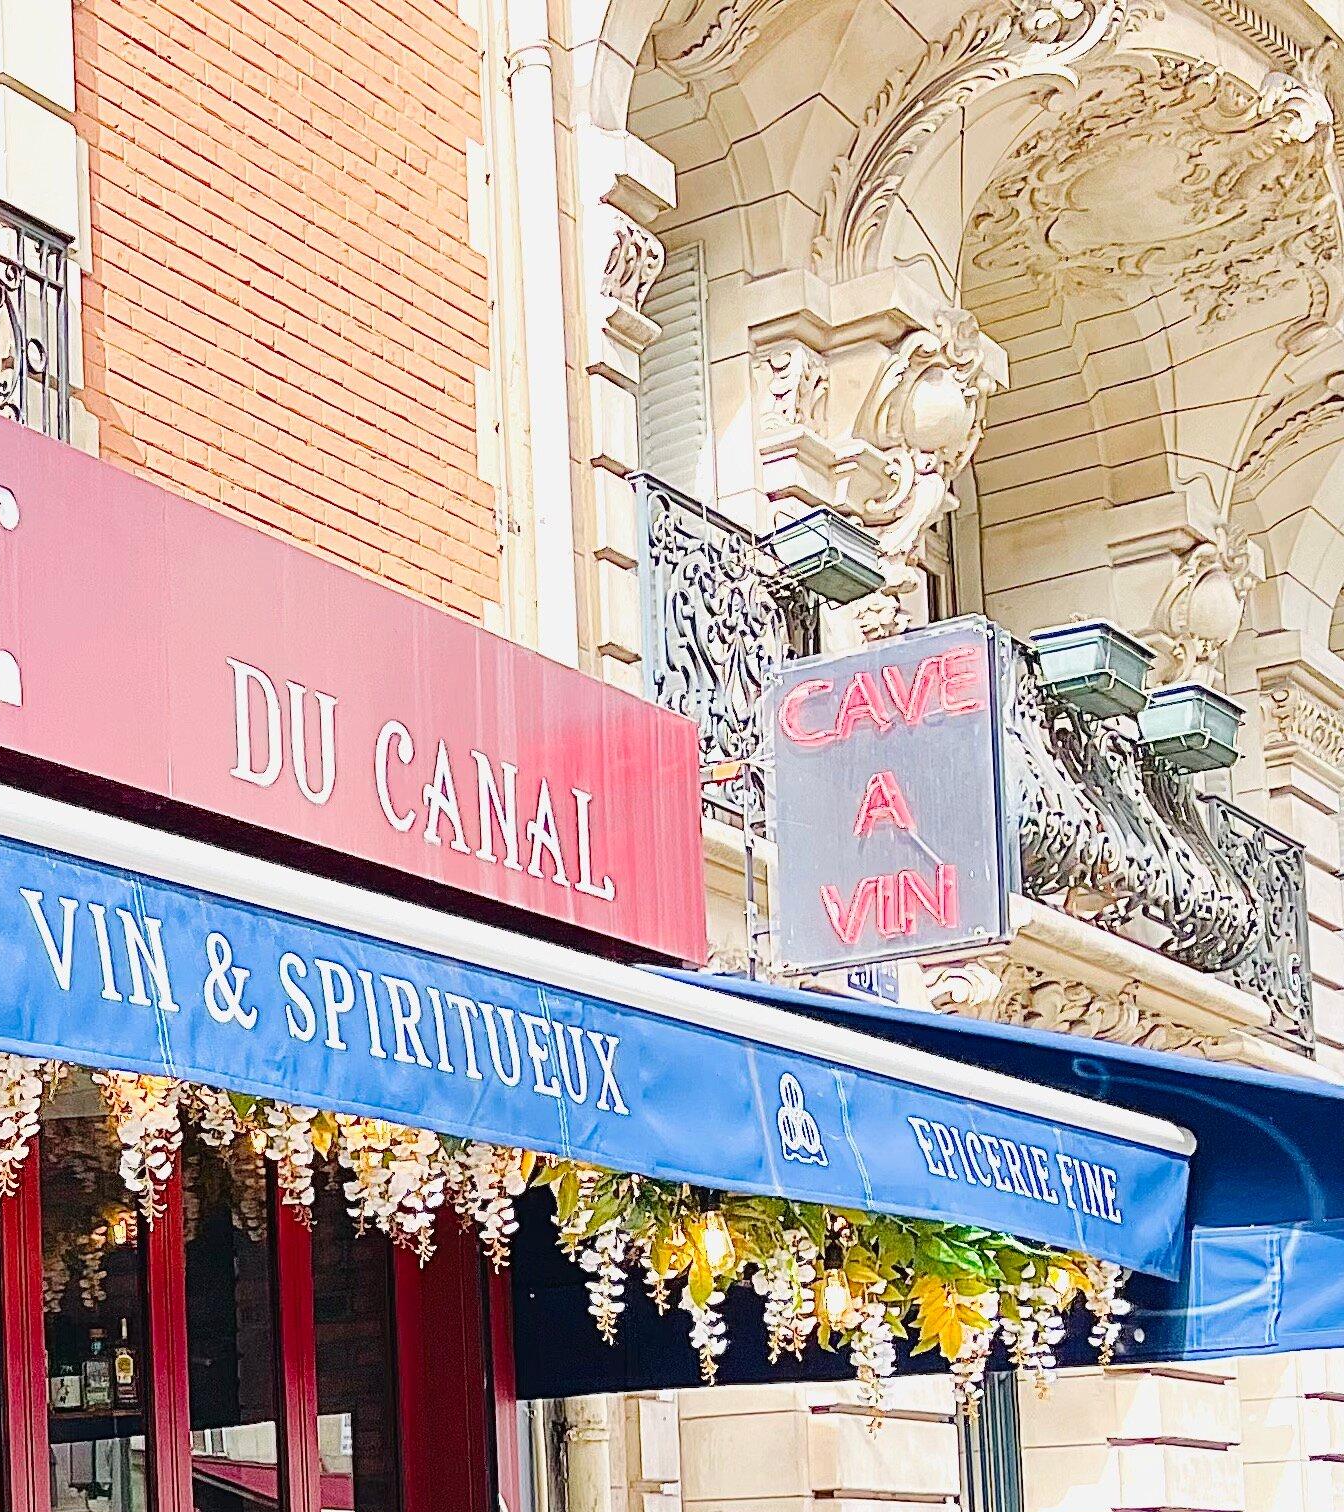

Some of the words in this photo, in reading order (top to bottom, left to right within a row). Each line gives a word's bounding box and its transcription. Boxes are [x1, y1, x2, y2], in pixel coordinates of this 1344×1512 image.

[777, 644, 987, 748] CAVE
[225, 655, 339, 806] DU
[374, 719, 617, 903] CANAL
[852, 769, 918, 838] A
[818, 862, 960, 946] VIN
[18, 885, 181, 1014] VIN
[202, 930, 259, 1031] &
[277, 950, 632, 1118] SPIRITUEUX
[907, 1115, 1060, 1206] EPICERIE
[1055, 1153, 1124, 1225] FINE
